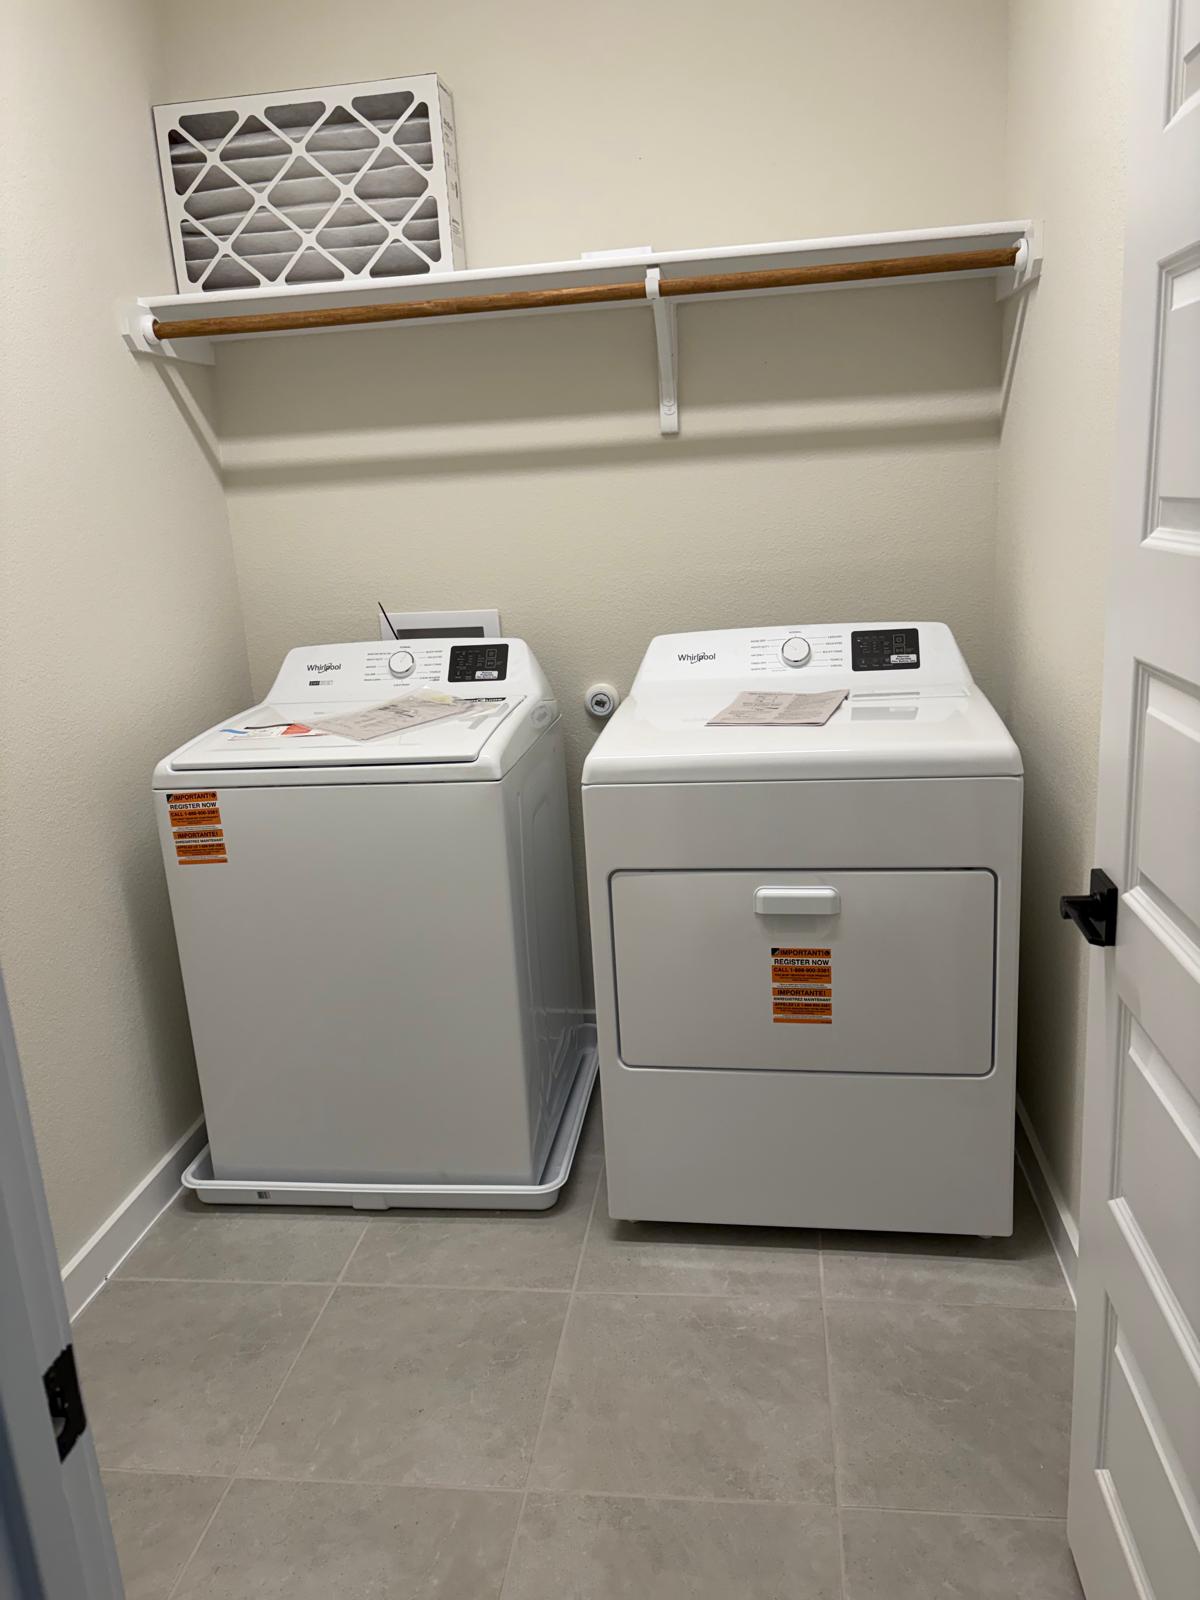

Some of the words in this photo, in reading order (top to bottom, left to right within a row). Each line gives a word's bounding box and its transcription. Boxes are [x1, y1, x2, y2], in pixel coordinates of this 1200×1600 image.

[677, 652, 716, 664] Whirlpool
[306, 662, 342, 673] Whirlpool
[774, 958, 811, 966] REGISTER
